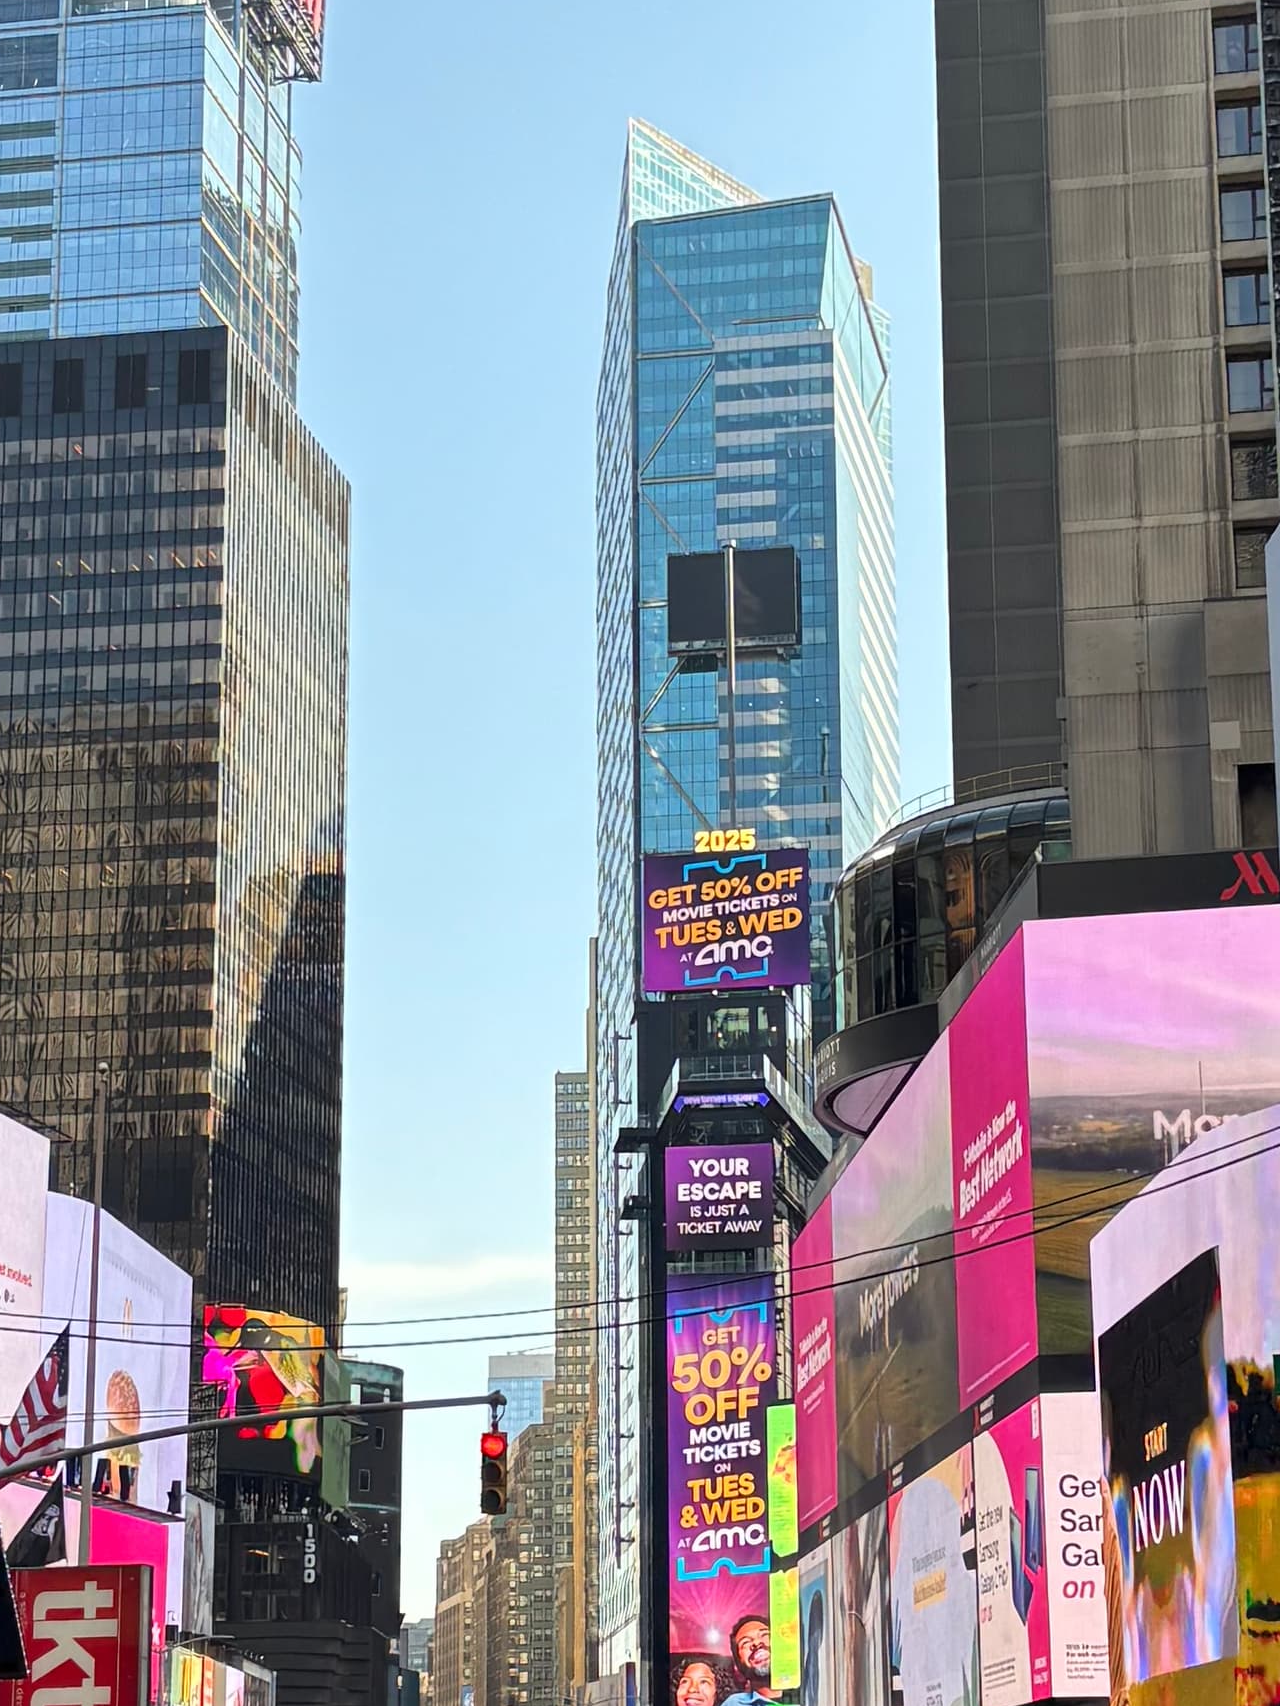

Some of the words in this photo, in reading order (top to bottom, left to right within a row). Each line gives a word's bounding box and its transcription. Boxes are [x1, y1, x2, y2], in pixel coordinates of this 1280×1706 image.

[694, 828, 756, 853] 2025
[648, 884, 697, 909] GET
[701, 876, 752, 902] 50%
[756, 867, 803, 892] OFF
[663, 905, 713, 924] MOVIE
[715, 895, 780, 916] TICKETS
[781, 893, 798, 904] ON
[655, 920, 722, 949] TUES
[726, 921, 737, 936] &
[738, 907, 803, 937] WED
[680, 952, 693, 963] AT
[688, 1158, 750, 1177] YOUR
[959, 1163, 980, 1220] Best
[981, 1118, 1024, 1199] Network
[677, 1181, 762, 1201] ESCAPE
[690, 1206, 702, 1217] IS
[704, 1204, 736, 1217] JUST
[739, 1204, 750, 1216] A
[677, 1221, 722, 1235] TICKET
[724, 1220, 763, 1233] AWAY
[702, 1326, 741, 1346] GET
[672, 1343, 772, 1393] 50%
[684, 1386, 760, 1425] OFF
[689, 1422, 751, 1445] MOVIE
[1144, 1422, 1168, 1462] START
[683, 1440, 761, 1464] TICKETS
[714, 1463, 732, 1473] ON
[687, 1473, 755, 1503] TUES
[1058, 1474, 1102, 1499] Ge
[680, 1505, 699, 1529] &
[701, 1496, 765, 1525] WED
[1133, 1459, 1186, 1553] NOW
[303, 1522, 317, 1584] 1500
[677, 1538, 691, 1549] AT
[1063, 1580, 1096, 1599] on
